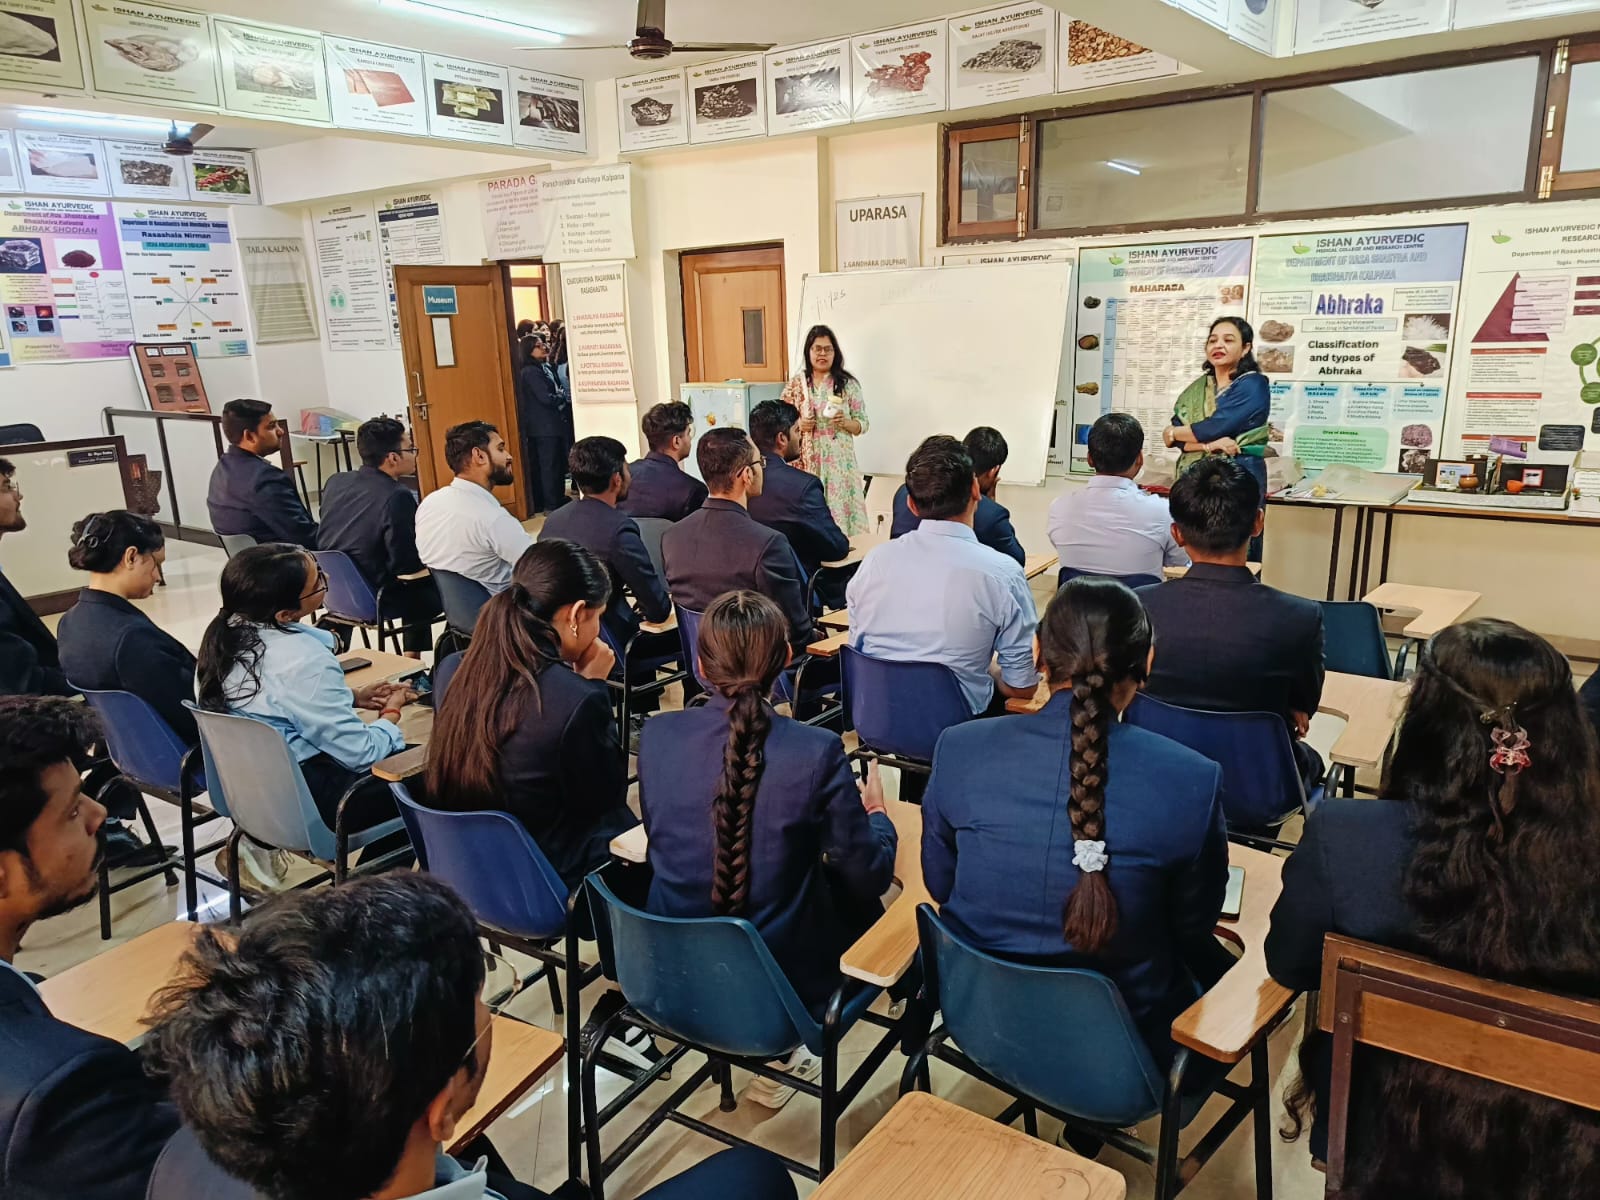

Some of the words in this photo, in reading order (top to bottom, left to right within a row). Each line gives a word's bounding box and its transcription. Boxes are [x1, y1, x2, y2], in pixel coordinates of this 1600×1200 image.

[113, 6, 144, 16] ISHAN
[148, 13, 201, 25] AYURVEDIC
[973, 17, 998, 26] ISHAN
[1000, 8, 1043, 20] AYURVEDIC
[874, 37, 896, 45] ISHAN
[897, 29, 937, 40] AYURVEDIC
[348, 46, 373, 55] ISHAN
[375, 52, 416, 62] AYURVEDIC
[704, 67, 724, 76] ISHAN
[725, 60, 757, 72] AYURVEDIC
[631, 79, 650, 87] ISHAN
[650, 73, 681, 83] AYURVEDIC
[487, 176, 526, 192] PARADA
[601, 173, 625, 183] Kalpana
[24, 201, 49, 209] ISHAN
[52, 202, 94, 210] AYURVEDIC
[171, 210, 208, 218] AYURVEDIC
[849, 204, 907, 223] UPARASA
[12, 224, 51, 233] ABHRAK
[53, 226, 98, 235] SHODHAN
[141, 231, 182, 239] Rasashala
[1525, 227, 1550, 235] ISHAN
[1551, 223, 1596, 232] AYURVEDIC
[1316, 237, 1353, 248] ISHAN
[1356, 233, 1425, 246] AYURVEDIC
[246, 245, 267, 253] TAILA
[267, 245, 300, 253] KALPANA
[1128, 249, 1159, 259] ISHAN
[1161, 246, 1219, 257] AYURVEDIC
[1511, 249, 1552, 258] Department
[1285, 255, 1335, 267] DEPARTMENT
[1337, 255, 1348, 266] OF
[1409, 251, 1428, 263] AND
[1129, 283, 1185, 293] MAHARASA
[427, 295, 454, 305] Museum
[1315, 293, 1385, 315] Abhraka
[1308, 340, 1379, 349] Classification
[1309, 352, 1329, 362] and
[1331, 353, 1361, 363] types
[1363, 352, 1376, 362] of
[1318, 366, 1363, 375] Abhraka
